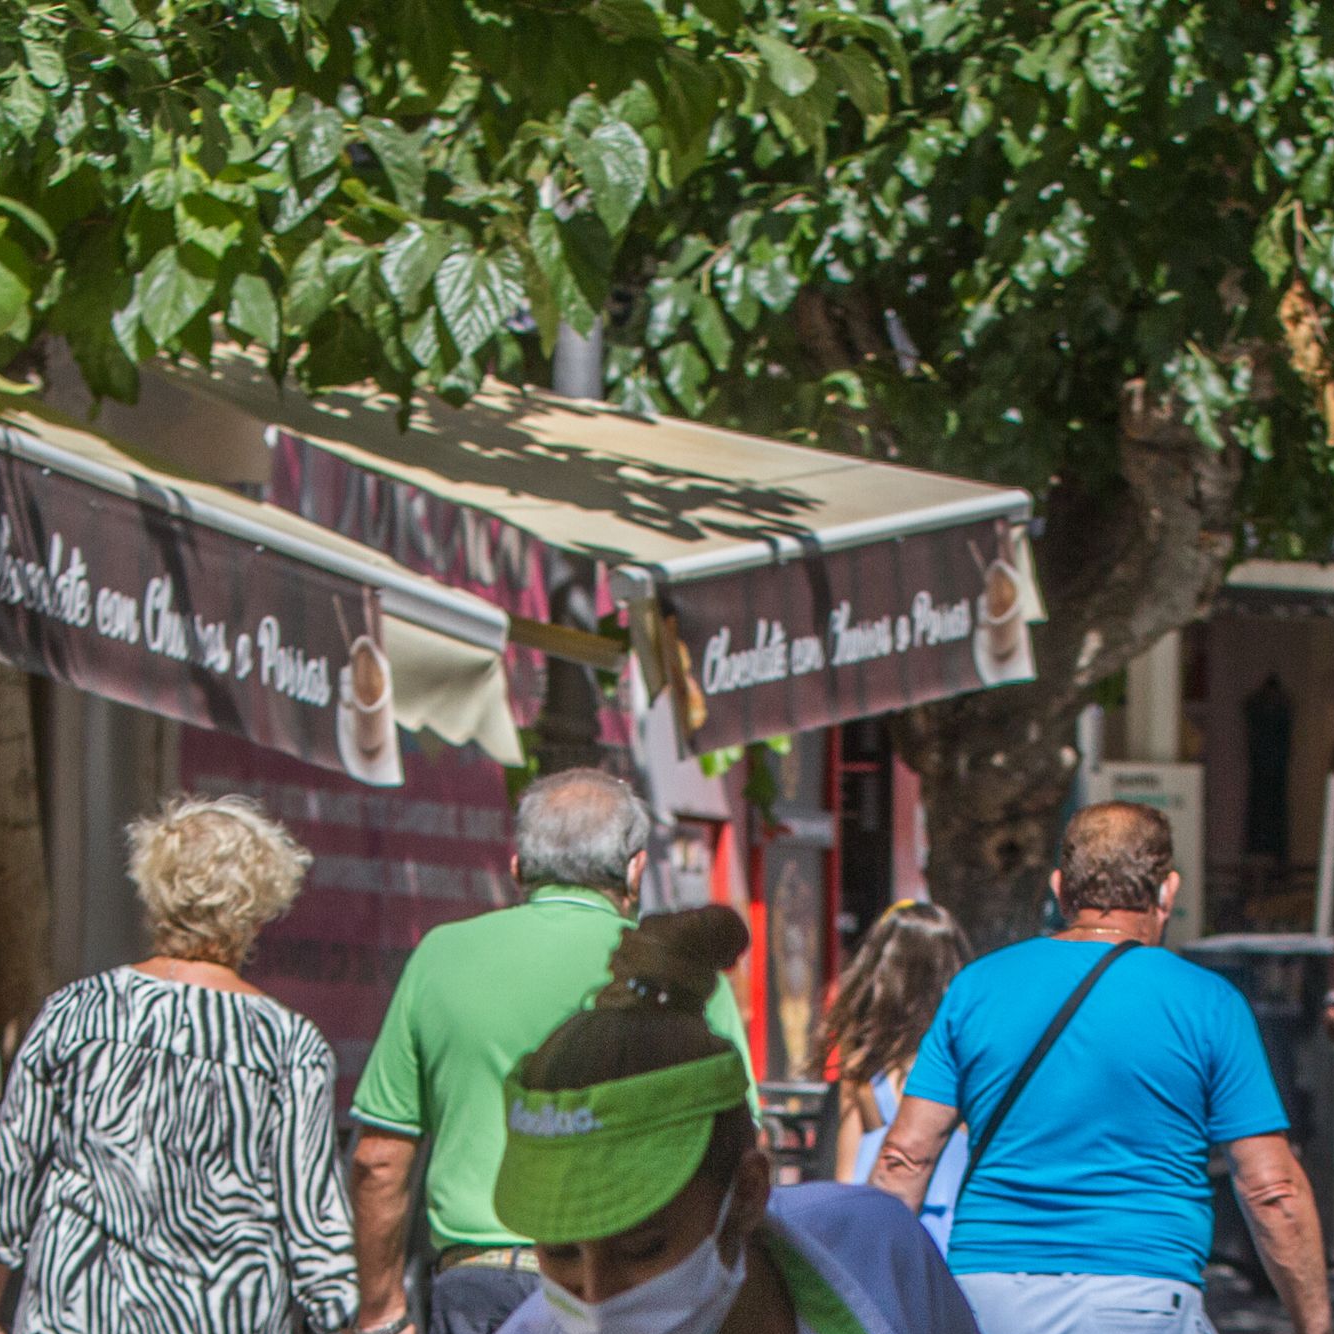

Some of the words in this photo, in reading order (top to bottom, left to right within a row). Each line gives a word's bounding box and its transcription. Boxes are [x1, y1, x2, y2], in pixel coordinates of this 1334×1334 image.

[96, 586, 141, 645] con
[257, 614, 332, 708] Porras
[702, 617, 788, 695] Chocolate
[790, 635, 824, 676] con
